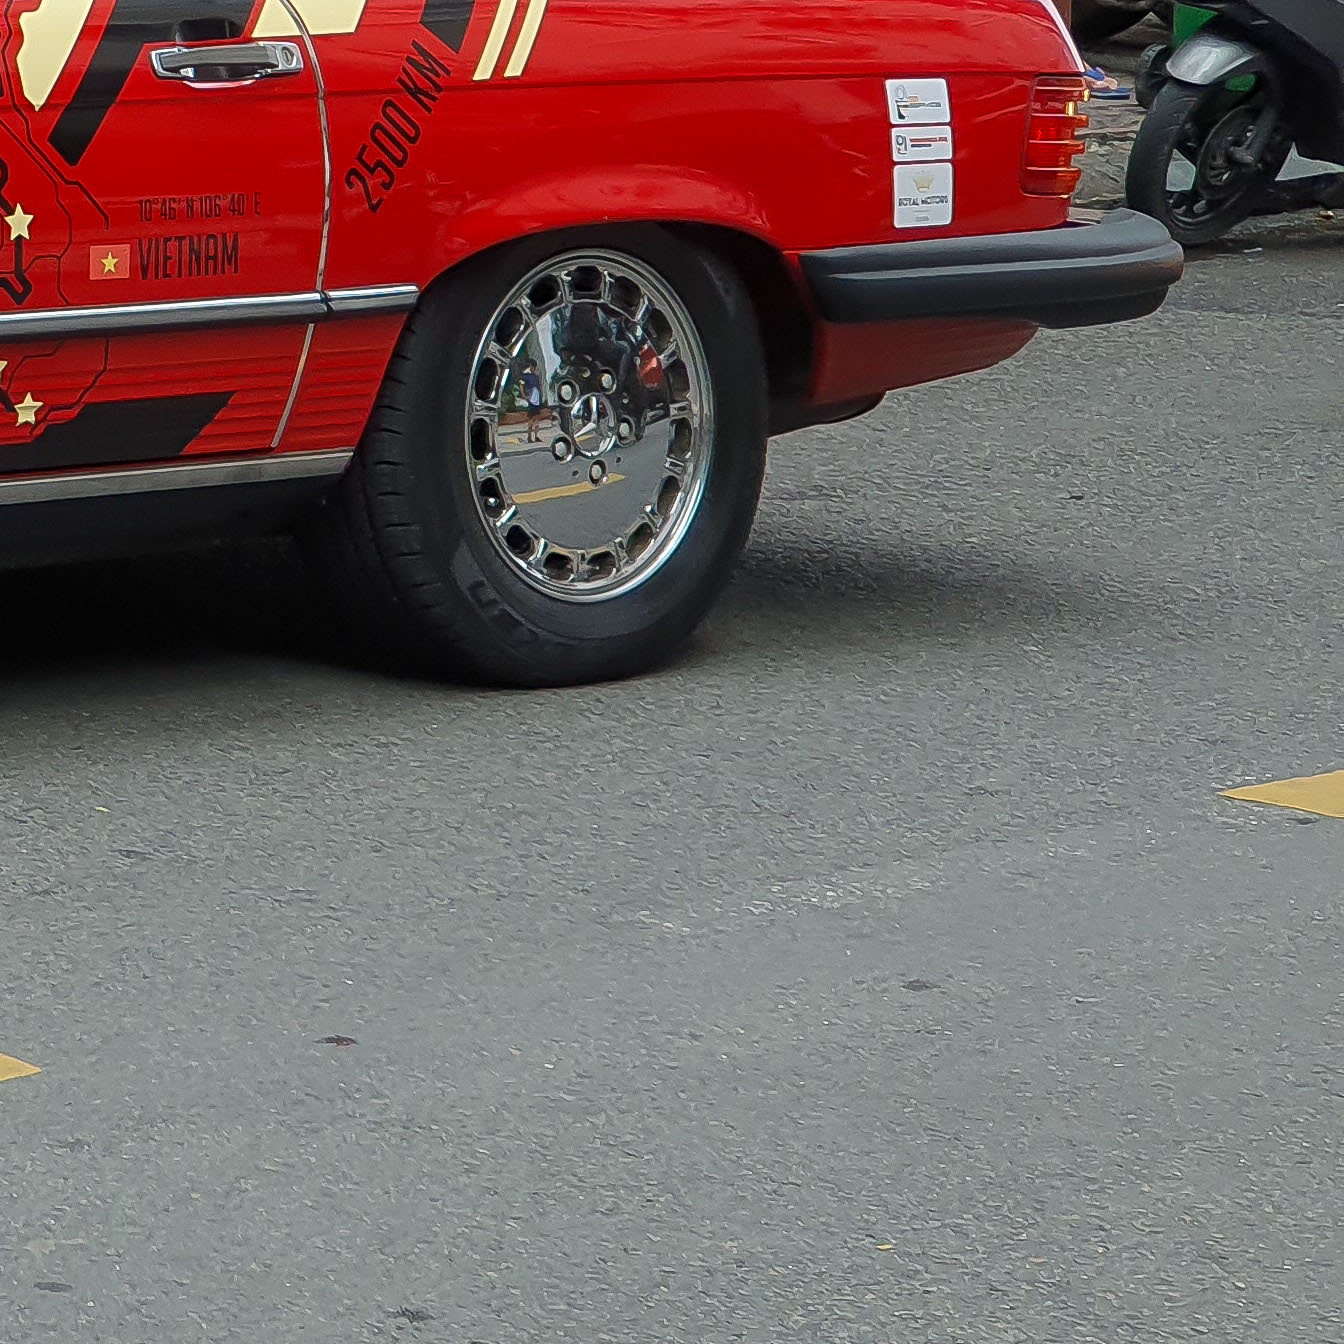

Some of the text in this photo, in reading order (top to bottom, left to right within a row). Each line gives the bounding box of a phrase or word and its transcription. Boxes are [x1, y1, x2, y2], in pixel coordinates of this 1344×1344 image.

[345, 39, 452, 213] 2500 KM
[138, 233, 240, 280] VIETNAM
